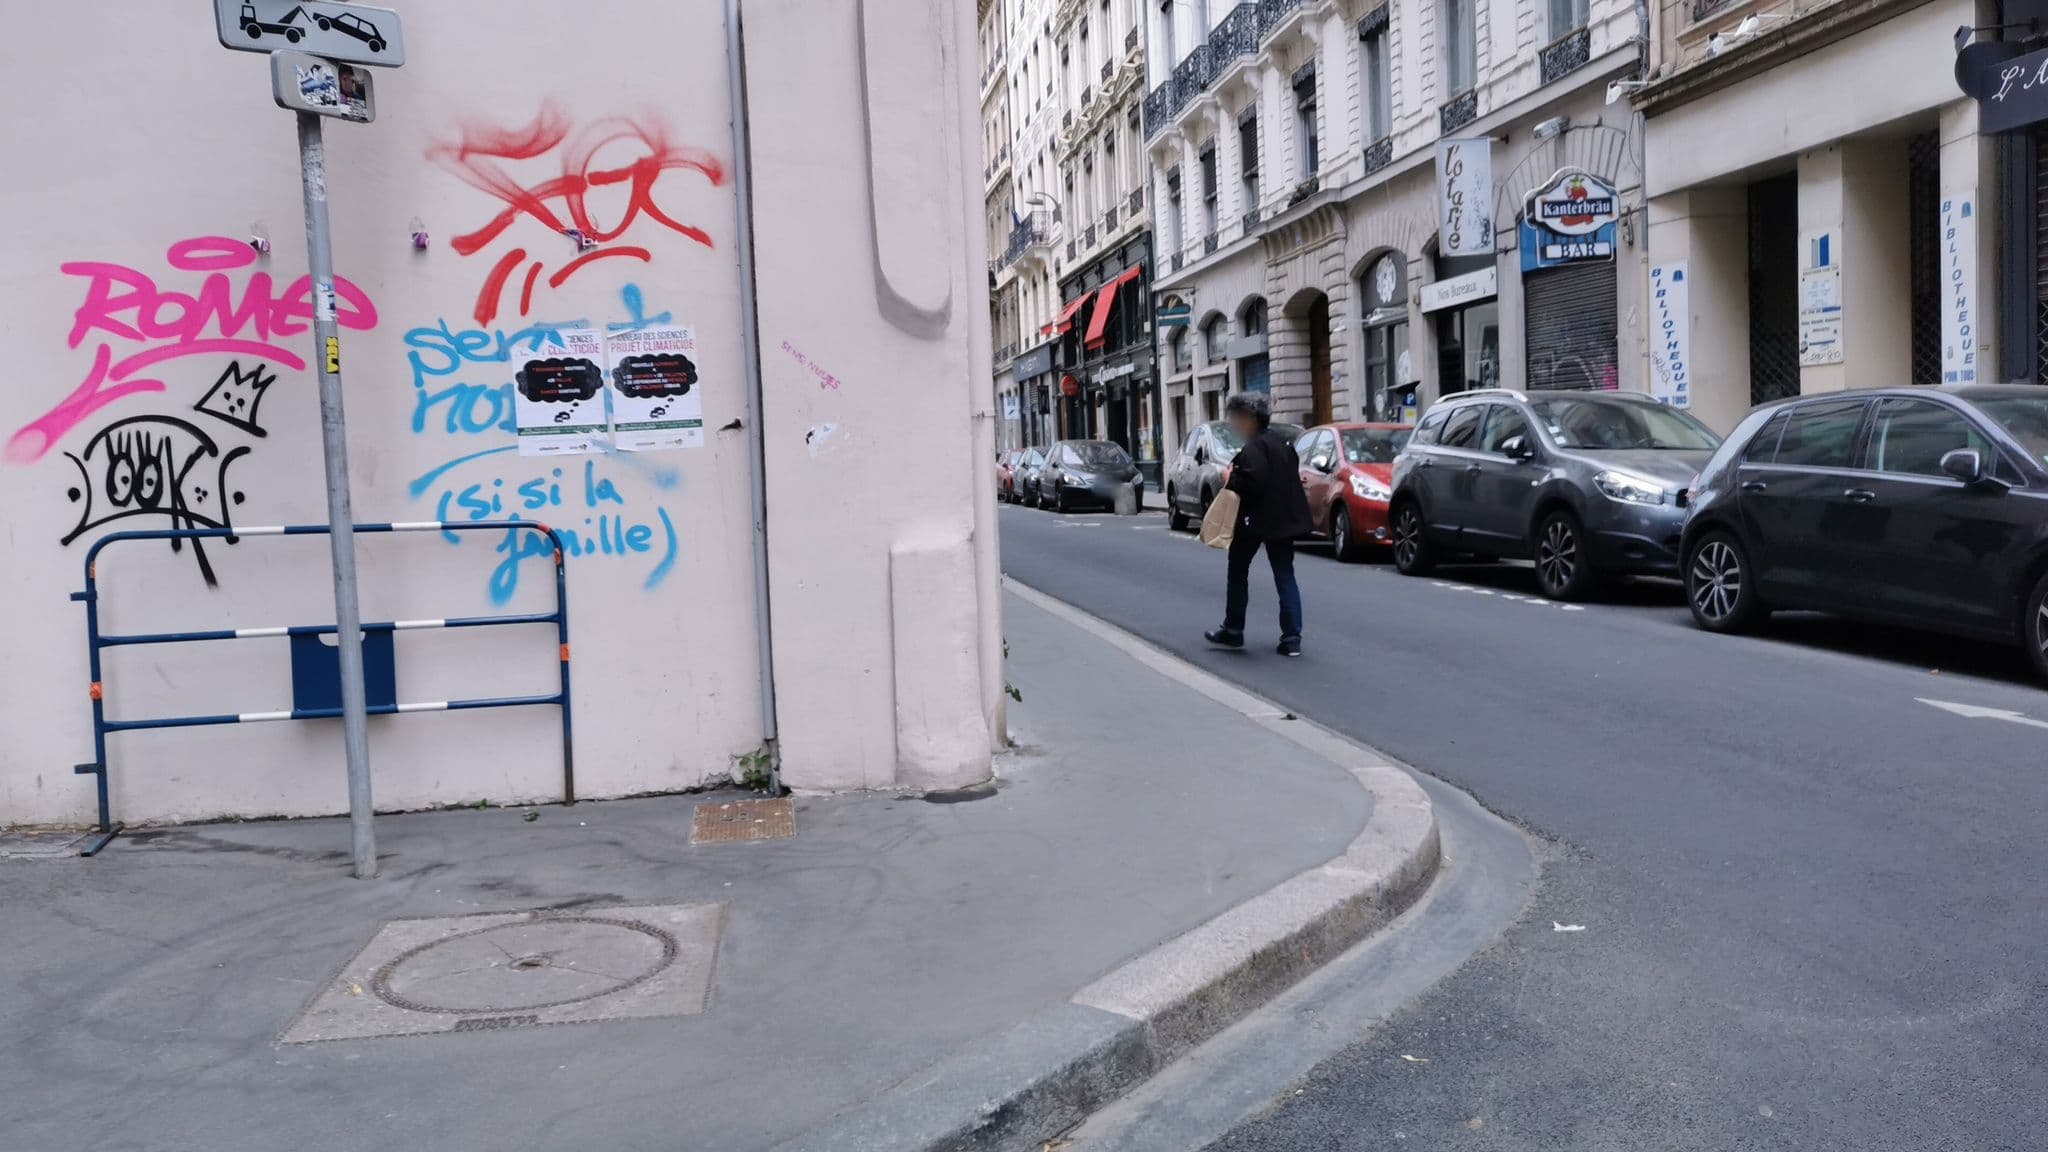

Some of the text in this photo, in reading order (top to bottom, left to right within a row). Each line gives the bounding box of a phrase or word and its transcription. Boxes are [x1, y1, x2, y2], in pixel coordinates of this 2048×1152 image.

[1543, 200, 1611, 216] Kanterbräu
[1562, 242, 1597, 257] BAR
[1942, 200, 1974, 364] BIBLIOTHEQUE
[643, 331, 656, 340] DES
[657, 329, 688, 340] SCIENCES
[1651, 268, 1688, 391] BIBLIOTHEQUE
[611, 338, 695, 353] PROJET CLIMATICIDE
[517, 466, 562, 509] si
[584, 458, 625, 508] la
